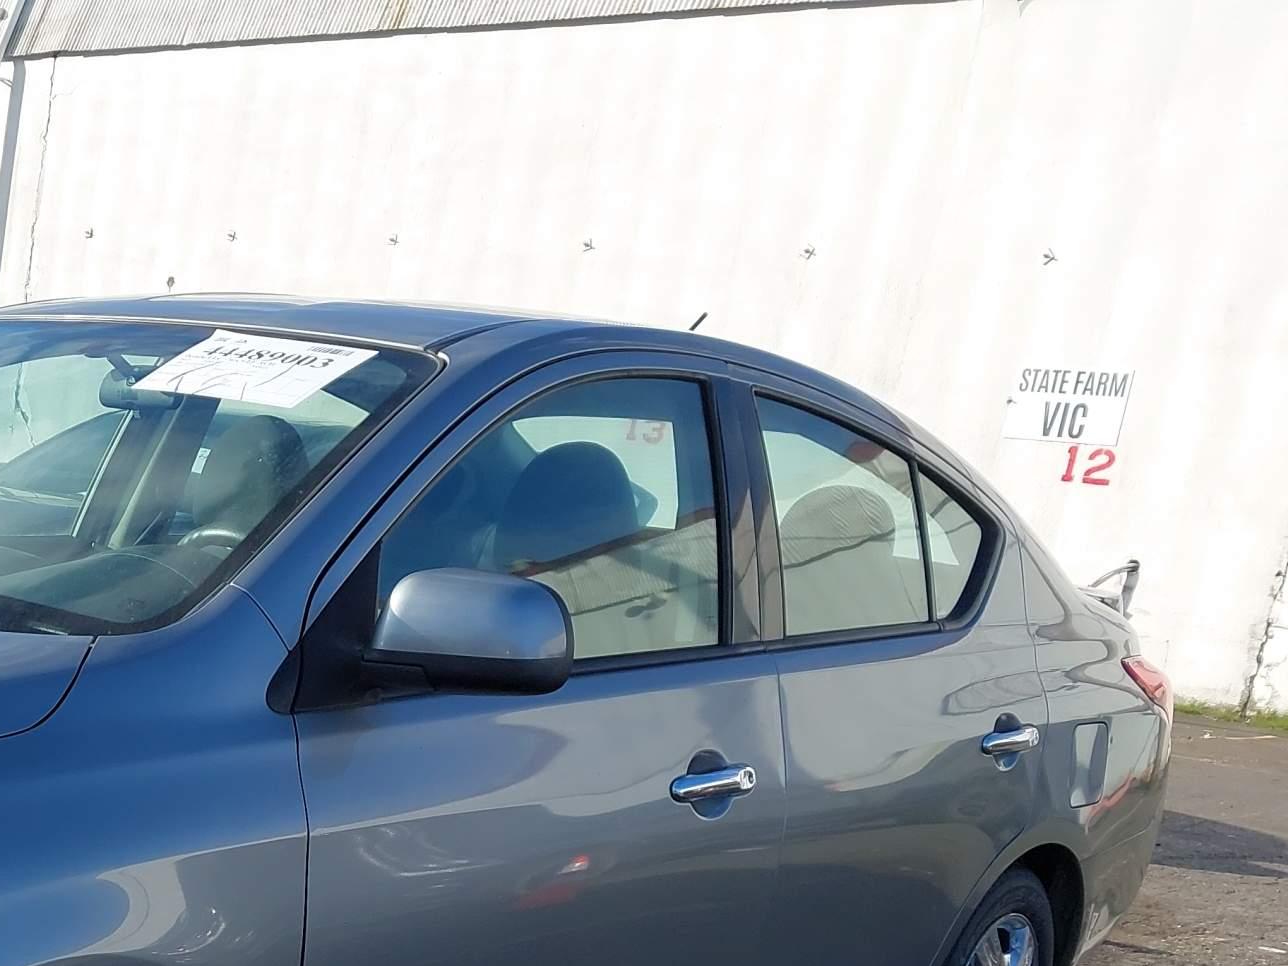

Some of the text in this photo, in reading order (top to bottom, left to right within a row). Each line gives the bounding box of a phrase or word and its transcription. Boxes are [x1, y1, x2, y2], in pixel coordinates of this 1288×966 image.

[203, 345, 335, 369] 44489003
[1018, 368, 1129, 398] STATE FARM
[1042, 401, 1089, 439] VIC
[1060, 445, 1116, 486] 12
